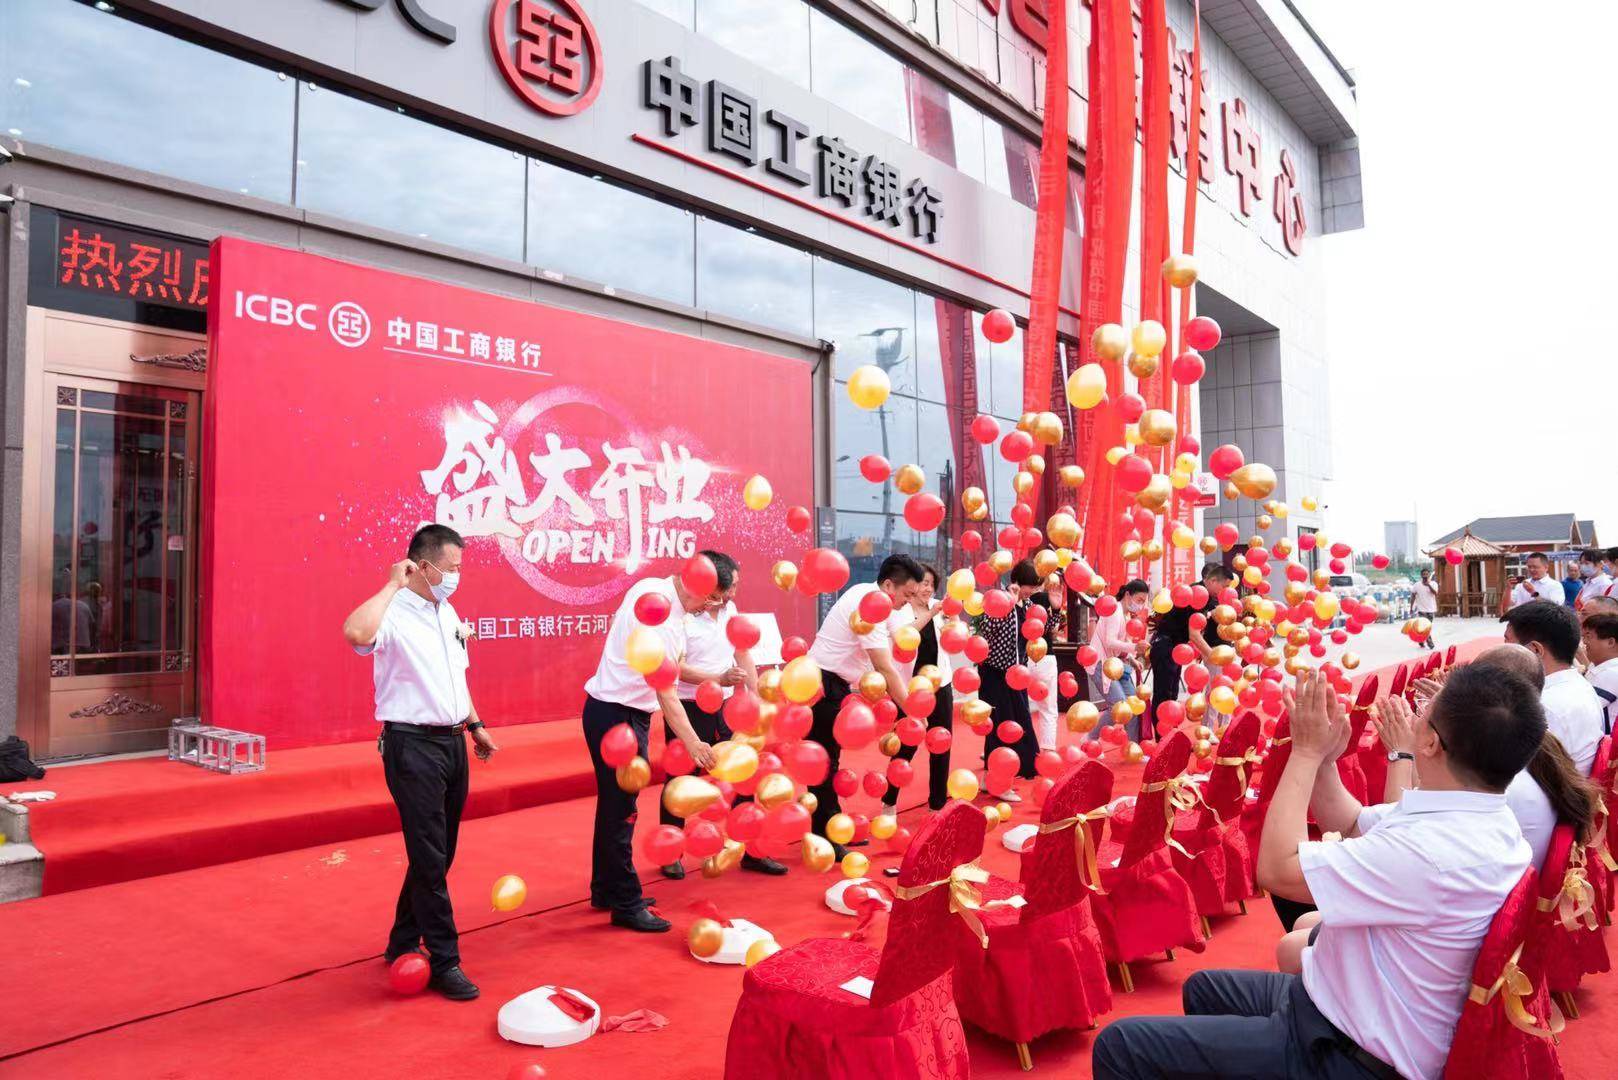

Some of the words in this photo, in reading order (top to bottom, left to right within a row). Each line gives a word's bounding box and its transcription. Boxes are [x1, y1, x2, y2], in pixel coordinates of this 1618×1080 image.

[644, 56, 945, 244] 中国工商银行
[1131, 0, 1306, 257] 销中心
[235, 291, 317, 331] ICBC
[387, 317, 542, 368] 中国工商银行
[420, 399, 716, 575] 盛大开业
[522, 527, 615, 564] OPEN
[647, 528, 696, 559] ING
[462, 613, 616, 640] 国工商银行石河
